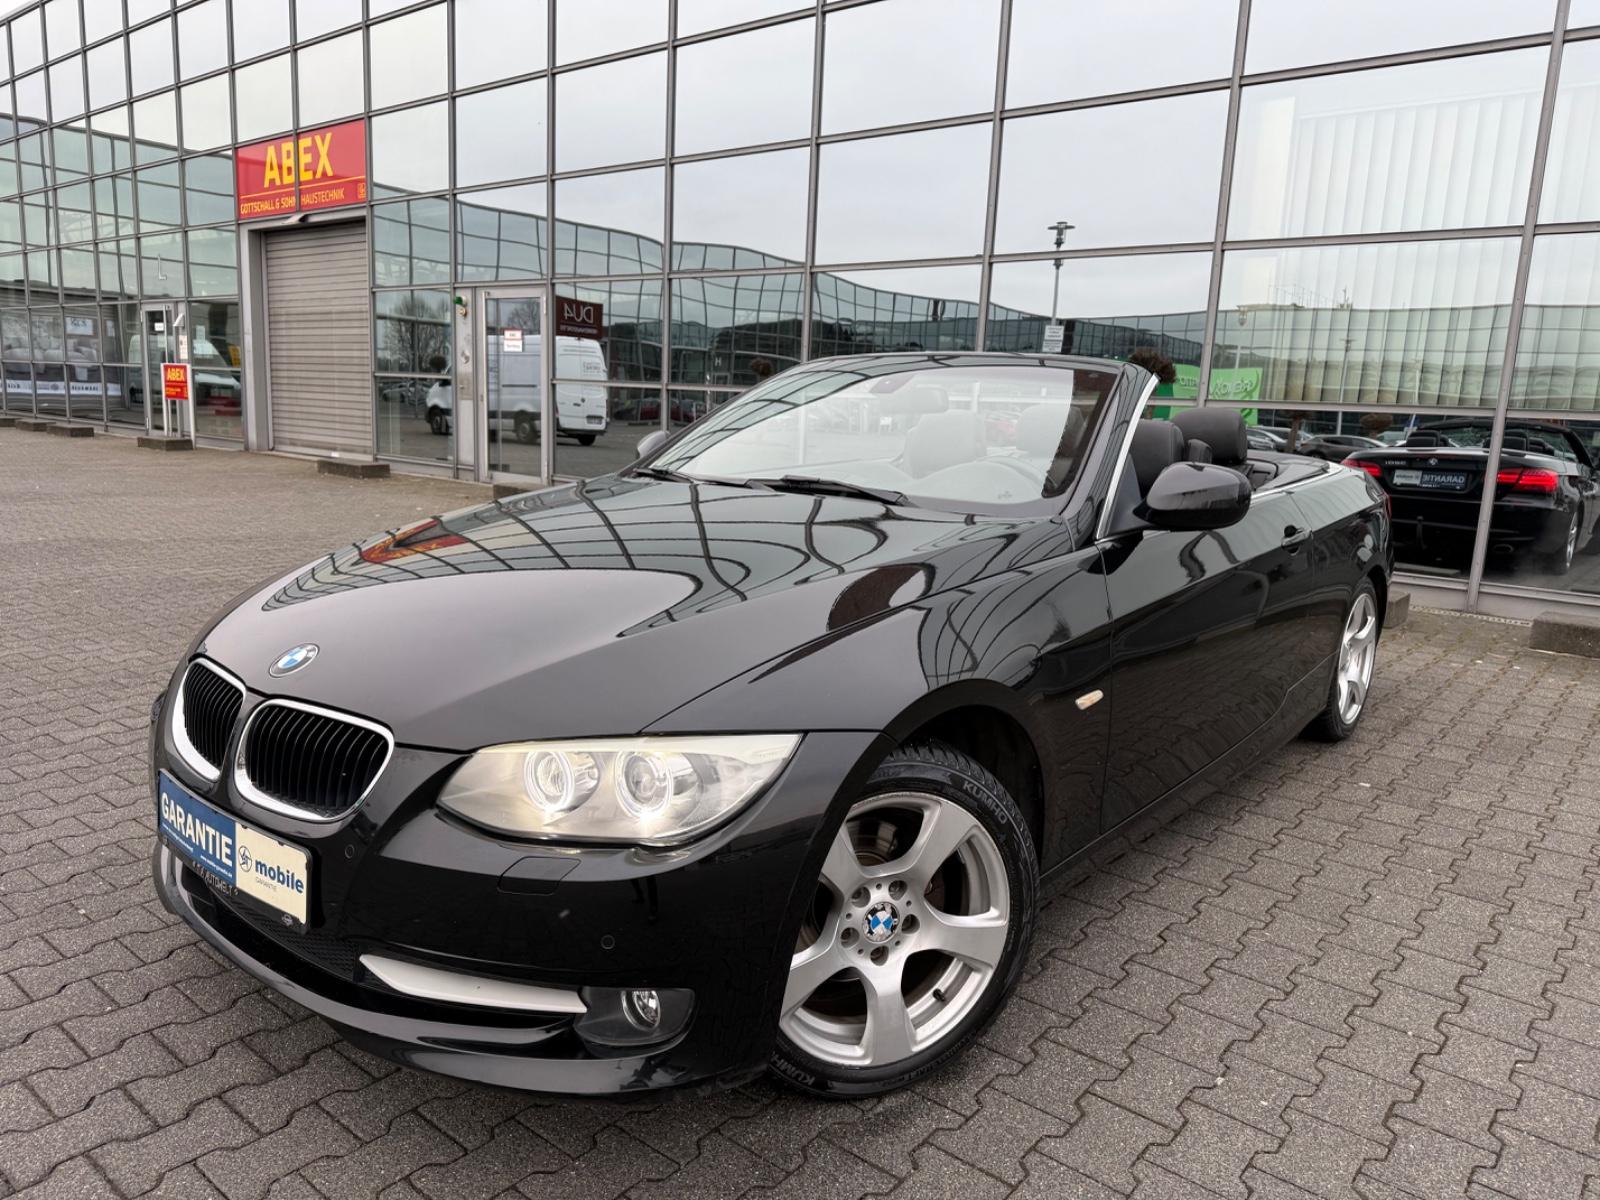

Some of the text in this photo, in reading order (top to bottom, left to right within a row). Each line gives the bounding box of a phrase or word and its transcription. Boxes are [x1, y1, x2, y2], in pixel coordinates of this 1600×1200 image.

[264, 132, 334, 188] ABEX
[240, 199, 276, 215] GOTTSCHALL
[301, 187, 345, 205] HAUSTECHNIK
[167, 367, 185, 381] ABEX
[962, 780, 1008, 825] KUMHO
[161, 792, 233, 867] GARANTIE
[255, 858, 304, 894] mobile
[771, 1051, 816, 1085] KUMH
